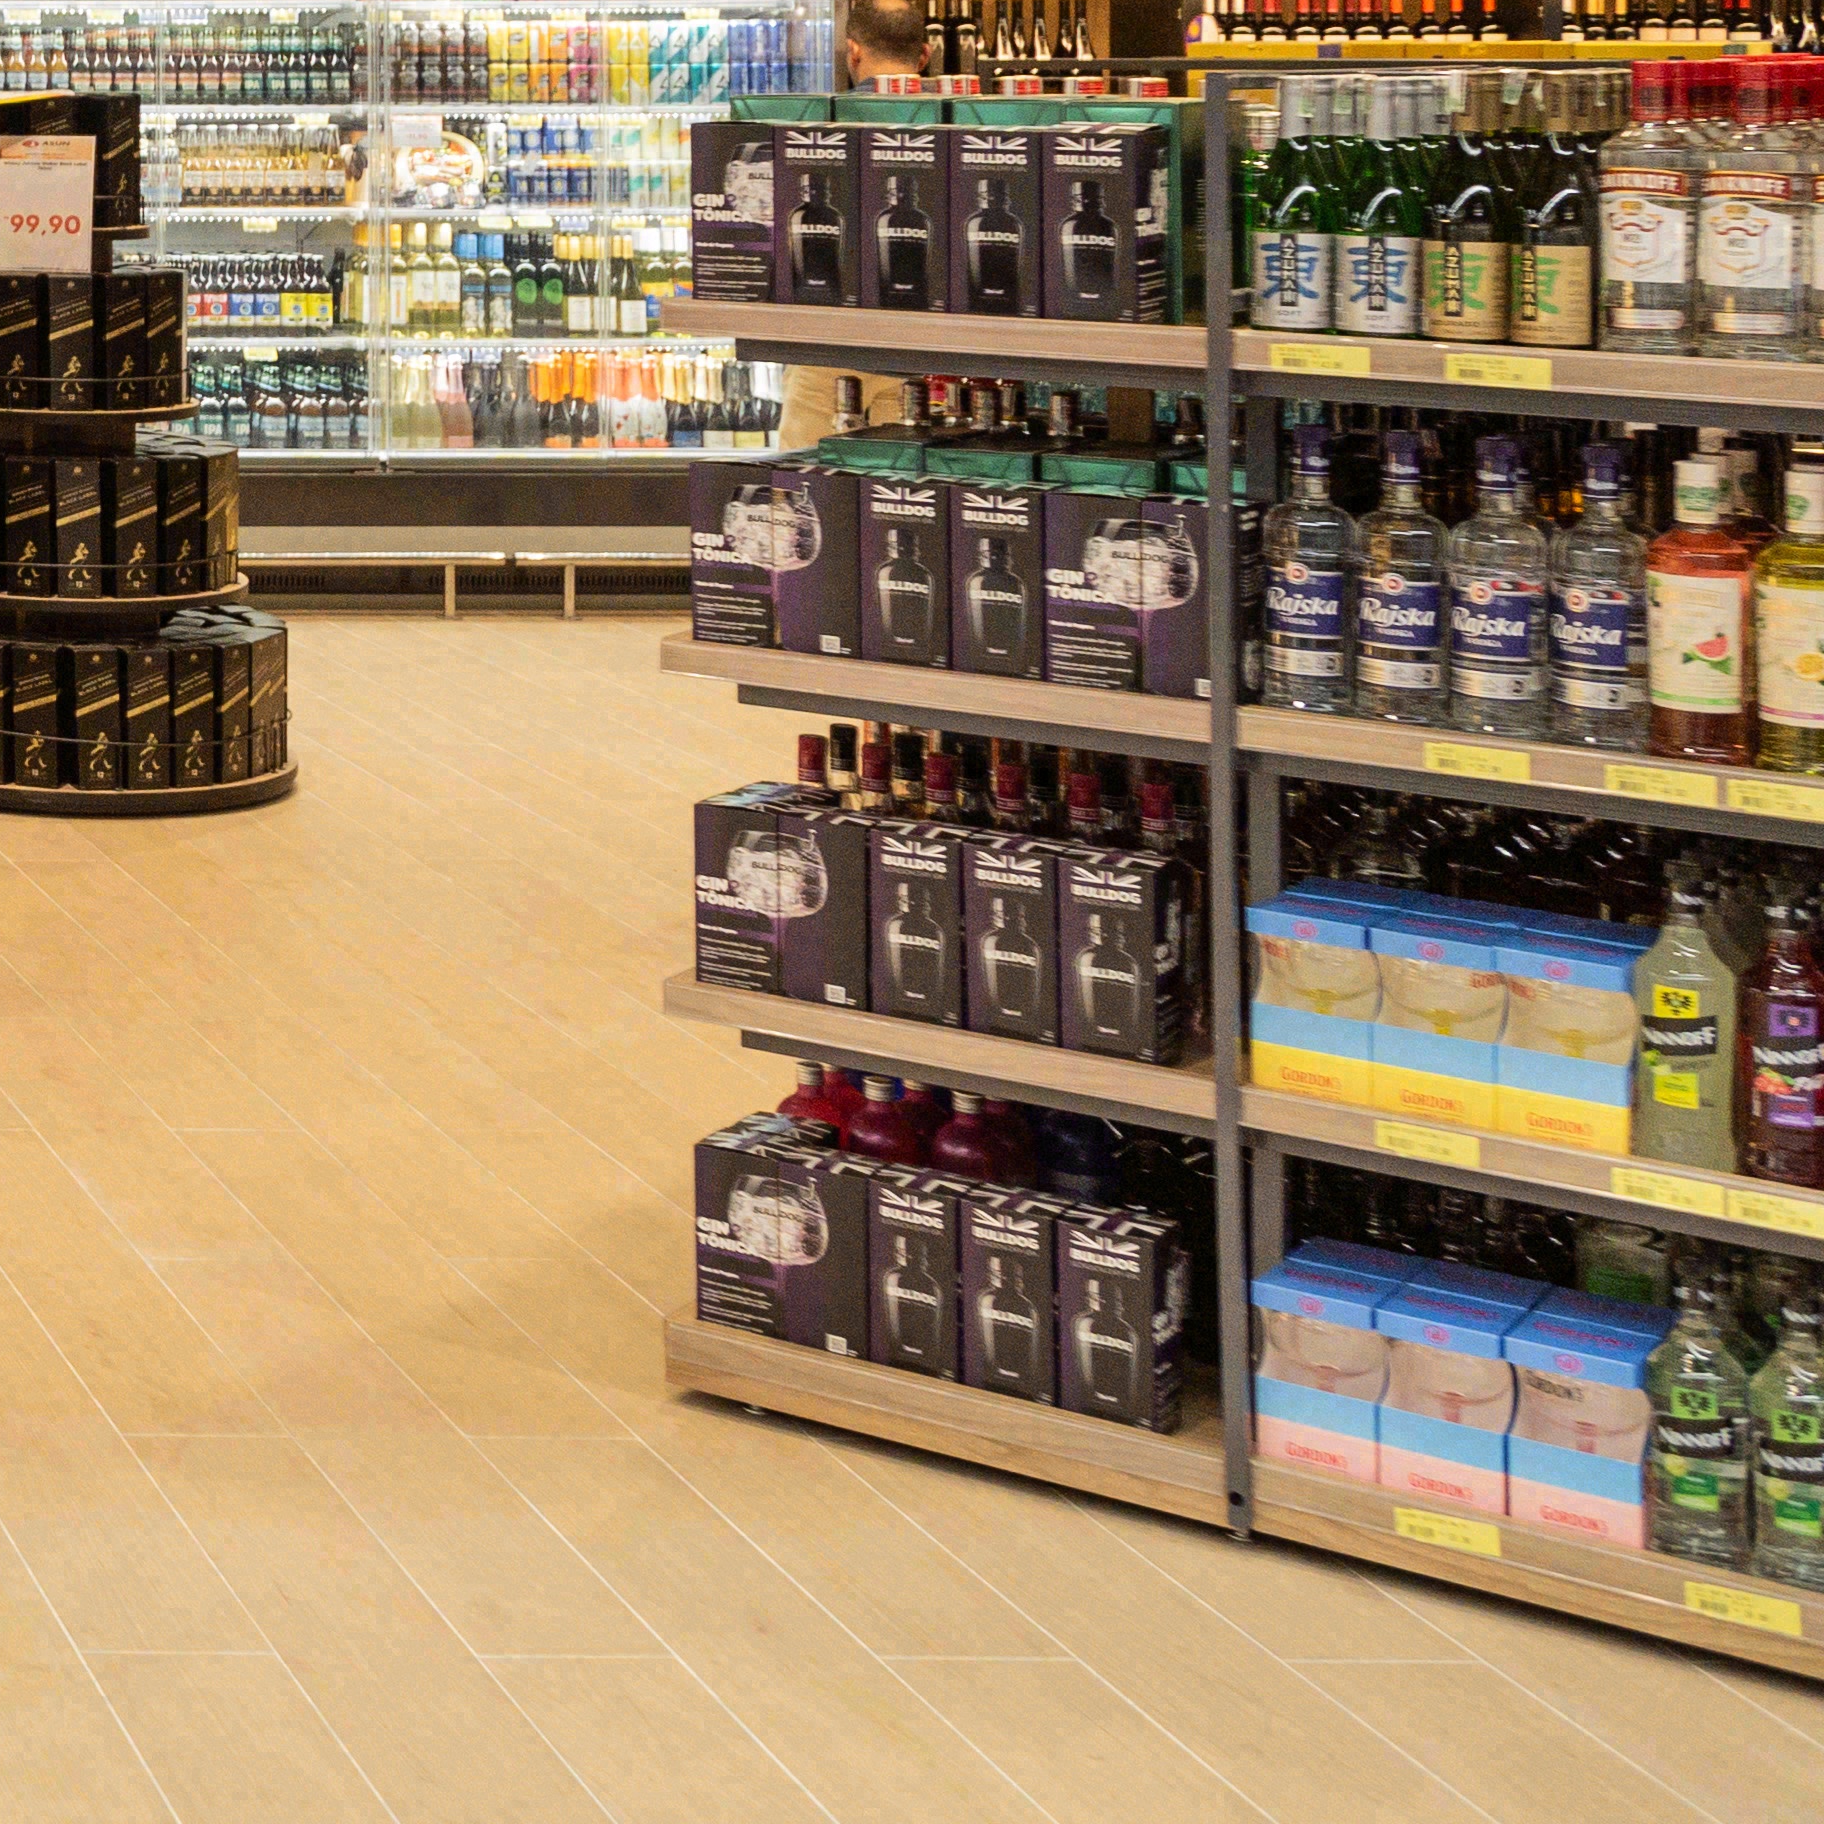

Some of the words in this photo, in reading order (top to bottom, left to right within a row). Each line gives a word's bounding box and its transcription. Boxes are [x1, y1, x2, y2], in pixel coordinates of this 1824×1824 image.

[785, 148, 846, 160] BULLDOG
[871, 150, 935, 162] BULLDOG
[961, 153, 1027, 165] BULLDOG
[1054, 155, 1123, 167] BULLDOG
[693, 193, 725, 207] GIN
[10, 214, 81, 236] 99,90
[871, 502, 935, 517] BULLDOG
[962, 510, 1029, 525] BULLDOG
[692, 532, 725, 547] GIN
[1046, 568, 1084, 584] GIN
[1267, 588, 1338, 616] Rajska
[1360, 597, 1435, 627] Rajska
[1452, 607, 1525, 637] Rajska
[881, 854, 947, 873] BULLDOG
[696, 875, 729, 891] GIN
[975, 868, 1042, 888] BULLDOG
[1070, 884, 1142, 904] BULLDOG
[696, 1217, 729, 1234] GIN
[879, 1205, 944, 1230] BULLDOG
